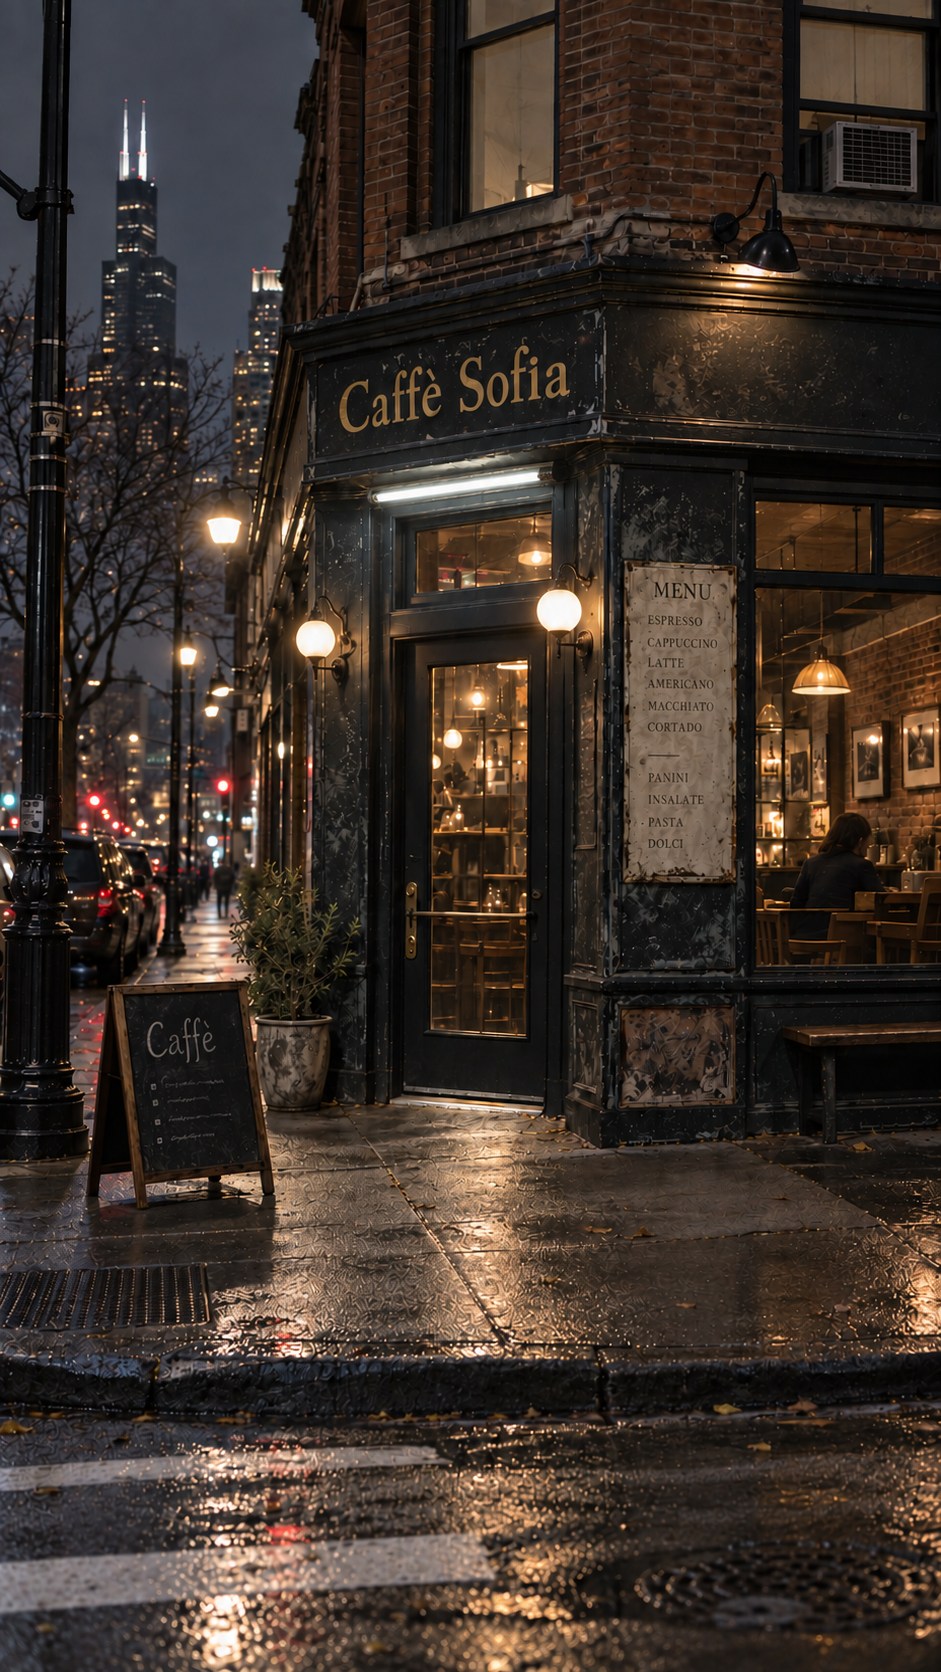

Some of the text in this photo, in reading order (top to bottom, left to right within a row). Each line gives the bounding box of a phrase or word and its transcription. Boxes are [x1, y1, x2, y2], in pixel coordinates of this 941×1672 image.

[339, 345, 571, 433] Caffè Sofia
[654, 581, 712, 601] MENU
[647, 614, 703, 627] ESPRESSO
[647, 637, 718, 649] CAPPUCCINO
[648, 657, 685, 668] LATTE
[647, 679, 714, 690] AMERICANO
[648, 701, 714, 712] MACCHIATO
[647, 722, 703, 733] CORTADO
[648, 772, 689, 783] PANINI
[648, 794, 705, 805] INSALATE
[648, 817, 684, 828] PASTA
[648, 838, 683, 849] DOLCI
[146, 1017, 216, 1063] Caffè
